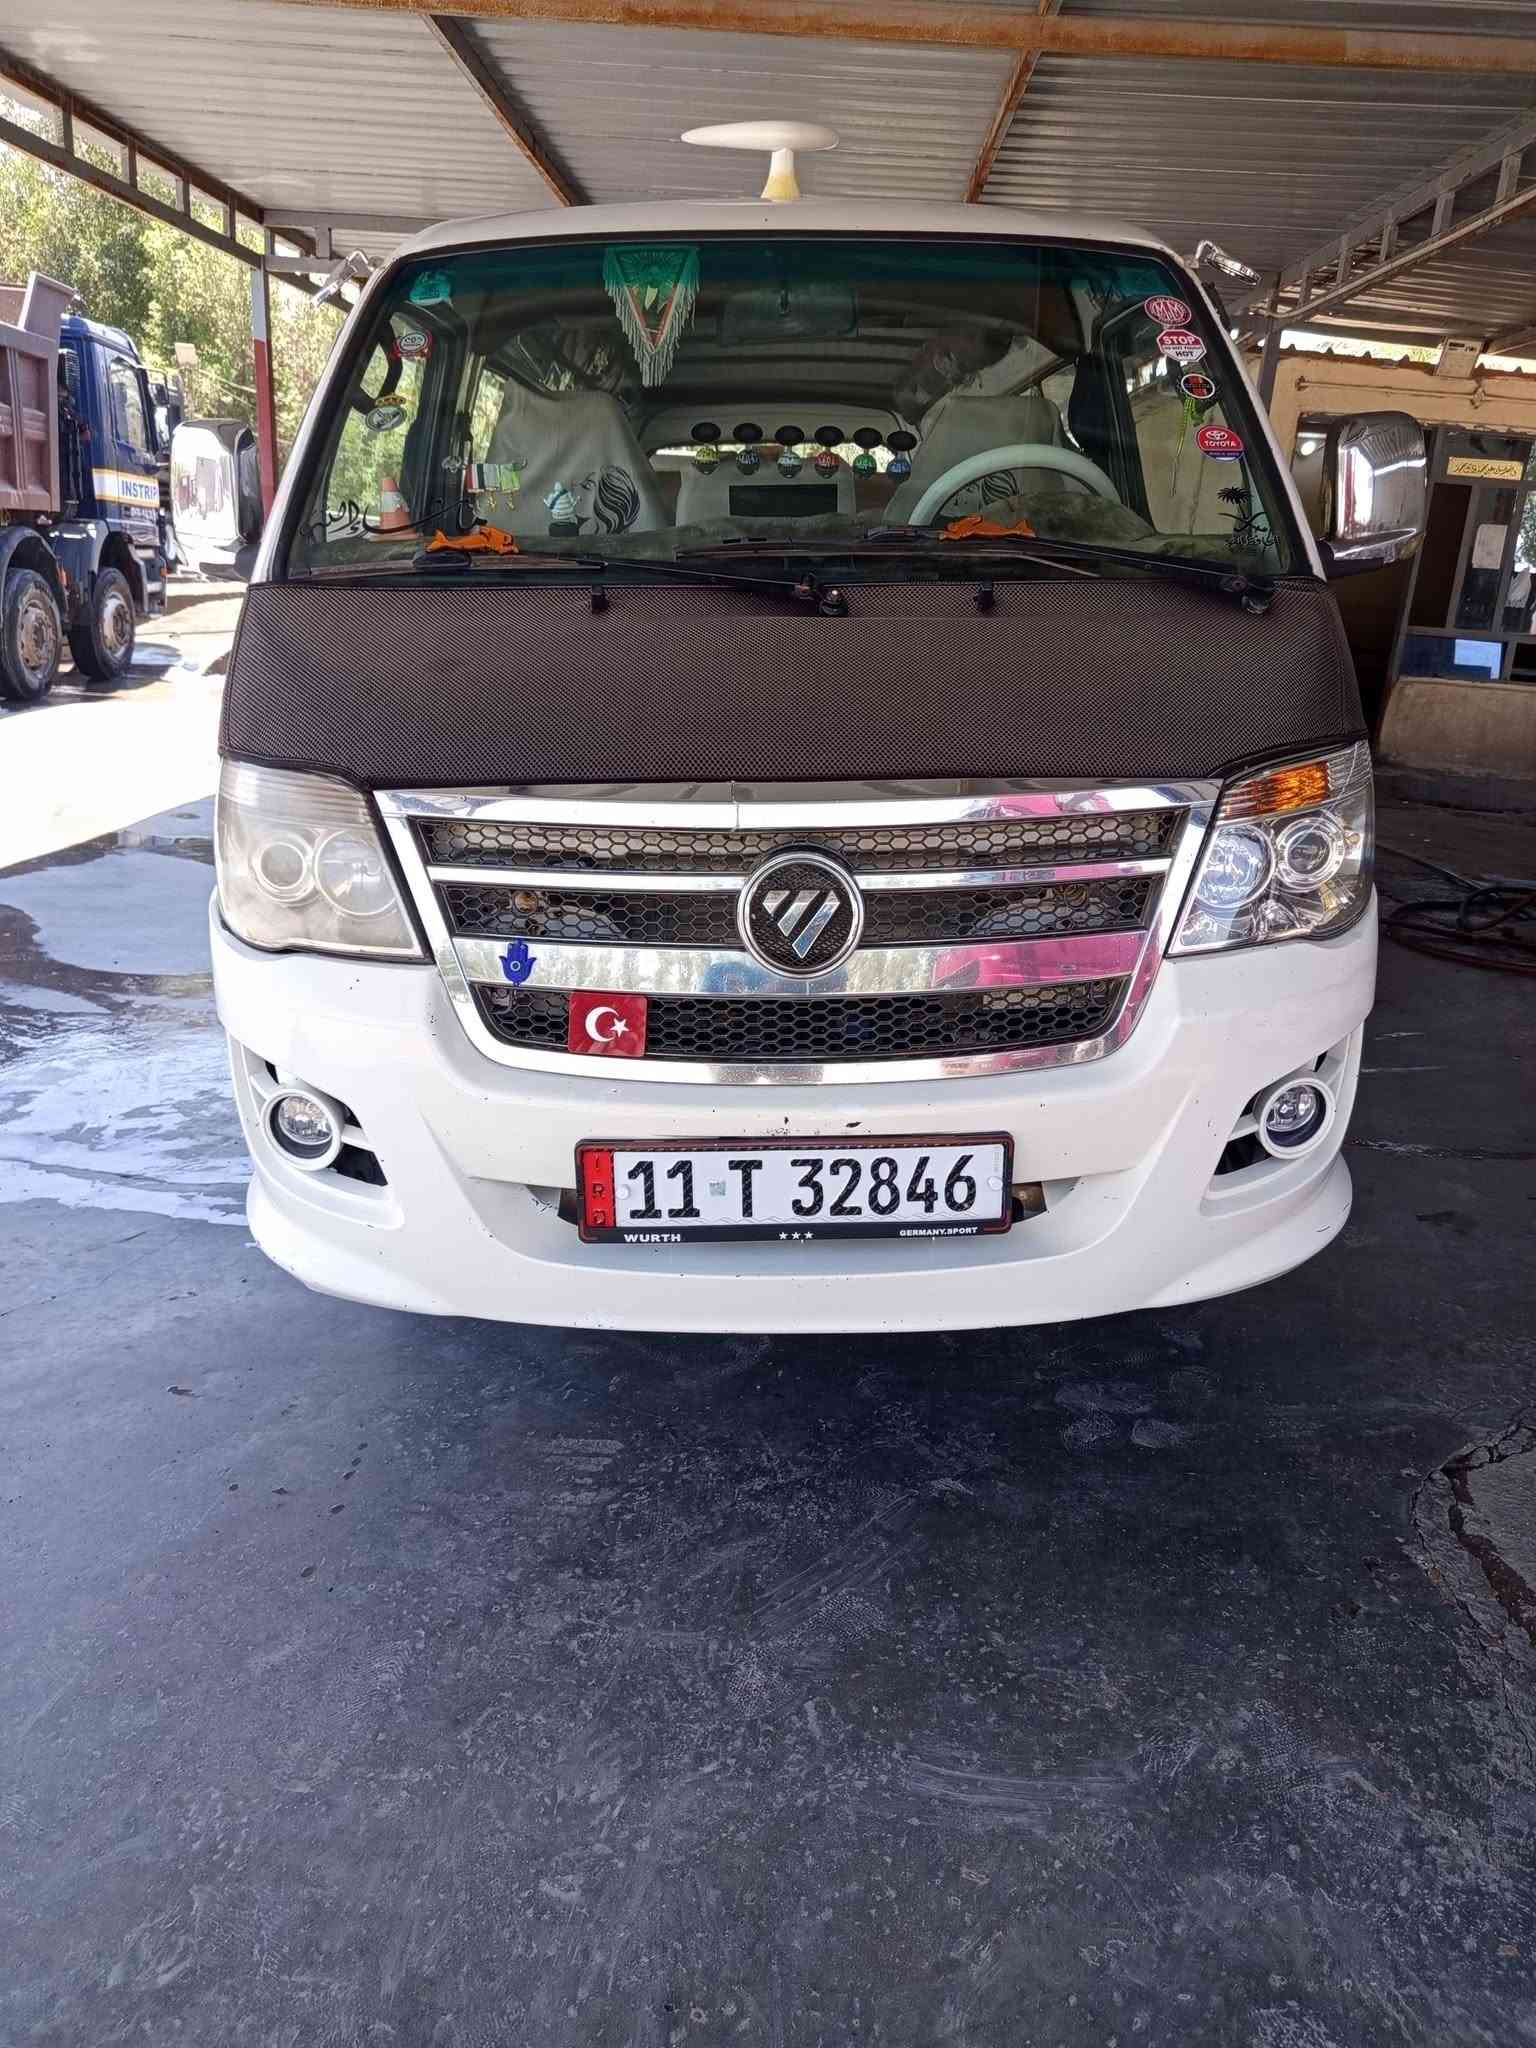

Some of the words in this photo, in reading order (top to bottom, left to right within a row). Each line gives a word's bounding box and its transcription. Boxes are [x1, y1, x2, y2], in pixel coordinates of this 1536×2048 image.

[1163, 336, 1196, 345] STOP
[1203, 440, 1237, 448] TOYOTA
[627, 1160, 701, 1219] 11
[728, 1159, 763, 1218] T
[790, 1155, 977, 1217] 32846
[899, 1227, 979, 1237] GERMANY.SPORT
[623, 1234, 682, 1243] WURTH
